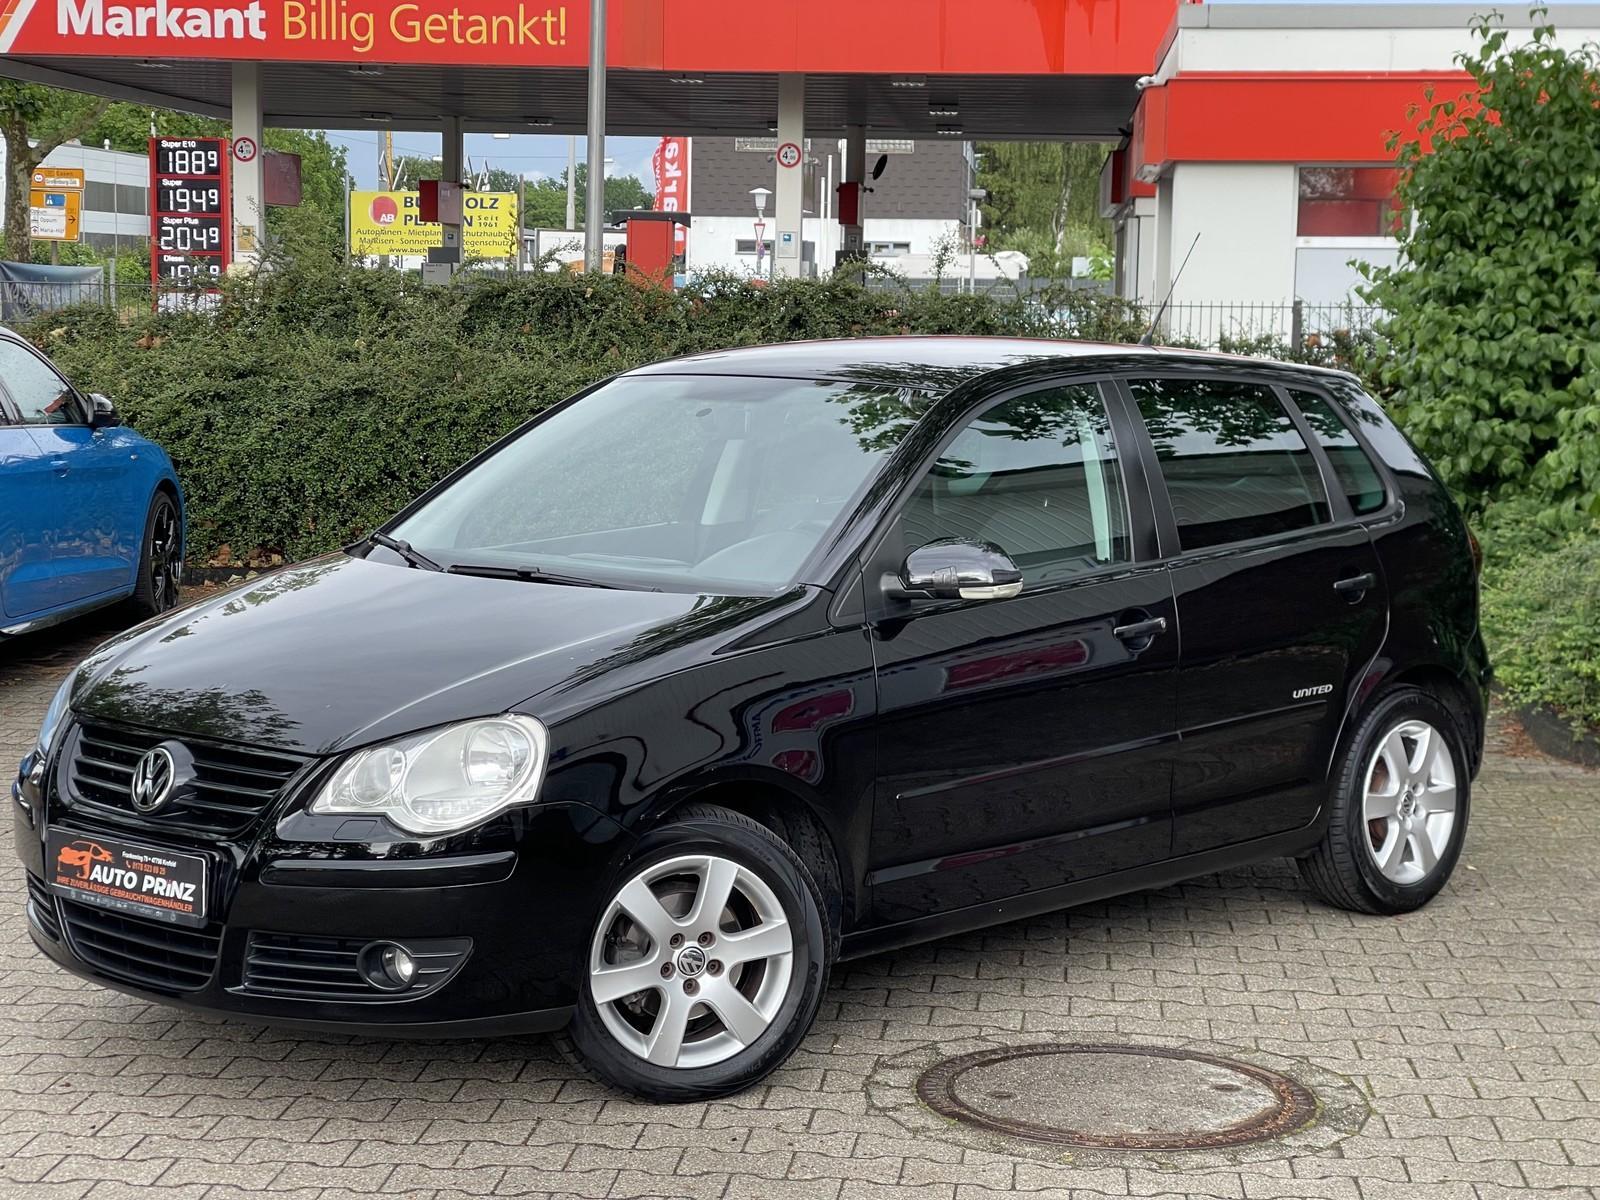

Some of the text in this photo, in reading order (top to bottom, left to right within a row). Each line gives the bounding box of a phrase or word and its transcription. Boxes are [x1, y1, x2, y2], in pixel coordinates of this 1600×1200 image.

[55, 0, 566, 52] Markant Billig Getankt!
[161, 140, 197, 148] Super E10
[162, 179, 183, 187] Super
[163, 217, 199, 225] Super Plus
[380, 213, 395, 223] AB
[356, 228, 402, 237] Autoplanen
[359, 237, 394, 245] Markisen
[1292, 684, 1334, 699] UNITED
[89, 864, 138, 890] AUTO
[56, 875, 71, 885] IHRE
[70, 877, 110, 896] ZUVERLÄSSIGE
[109, 886, 193, 913] GEBRAUCHTWAGENHÄNDLER
